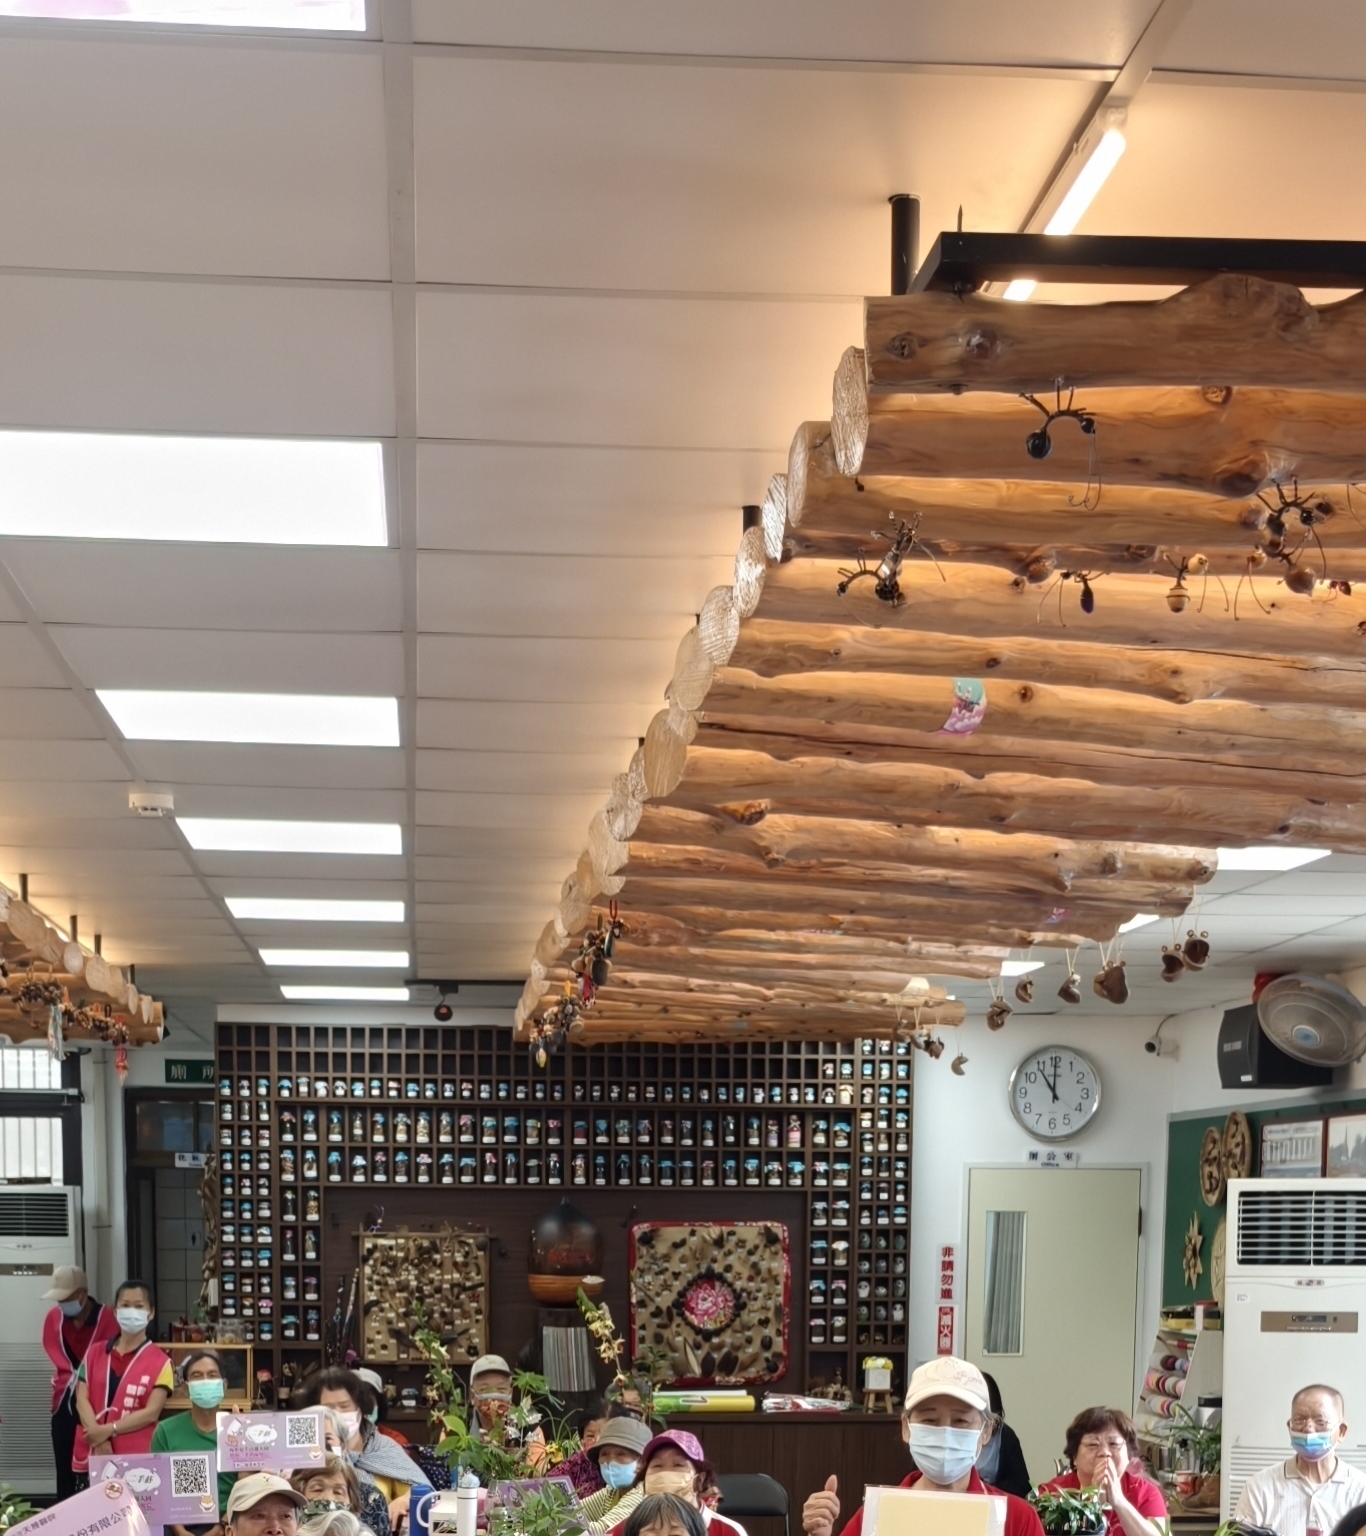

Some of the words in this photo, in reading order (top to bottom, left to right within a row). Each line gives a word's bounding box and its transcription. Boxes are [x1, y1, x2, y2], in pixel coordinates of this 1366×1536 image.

[1069, 1060, 1074, 1072] 1
[1024, 1071, 1037, 1084] 10
[1076, 1071, 1085, 1084] 2
[1018, 1086, 1027, 1099] 9
[1080, 1087, 1090, 1100] 3
[1023, 1102, 1032, 1114] 8
[1074, 1102, 1083, 1113] 4
[1035, 1113, 1043, 1125] 7
[1048, 1118, 1057, 1130] 6
[1062, 1113, 1071, 1126] 5
